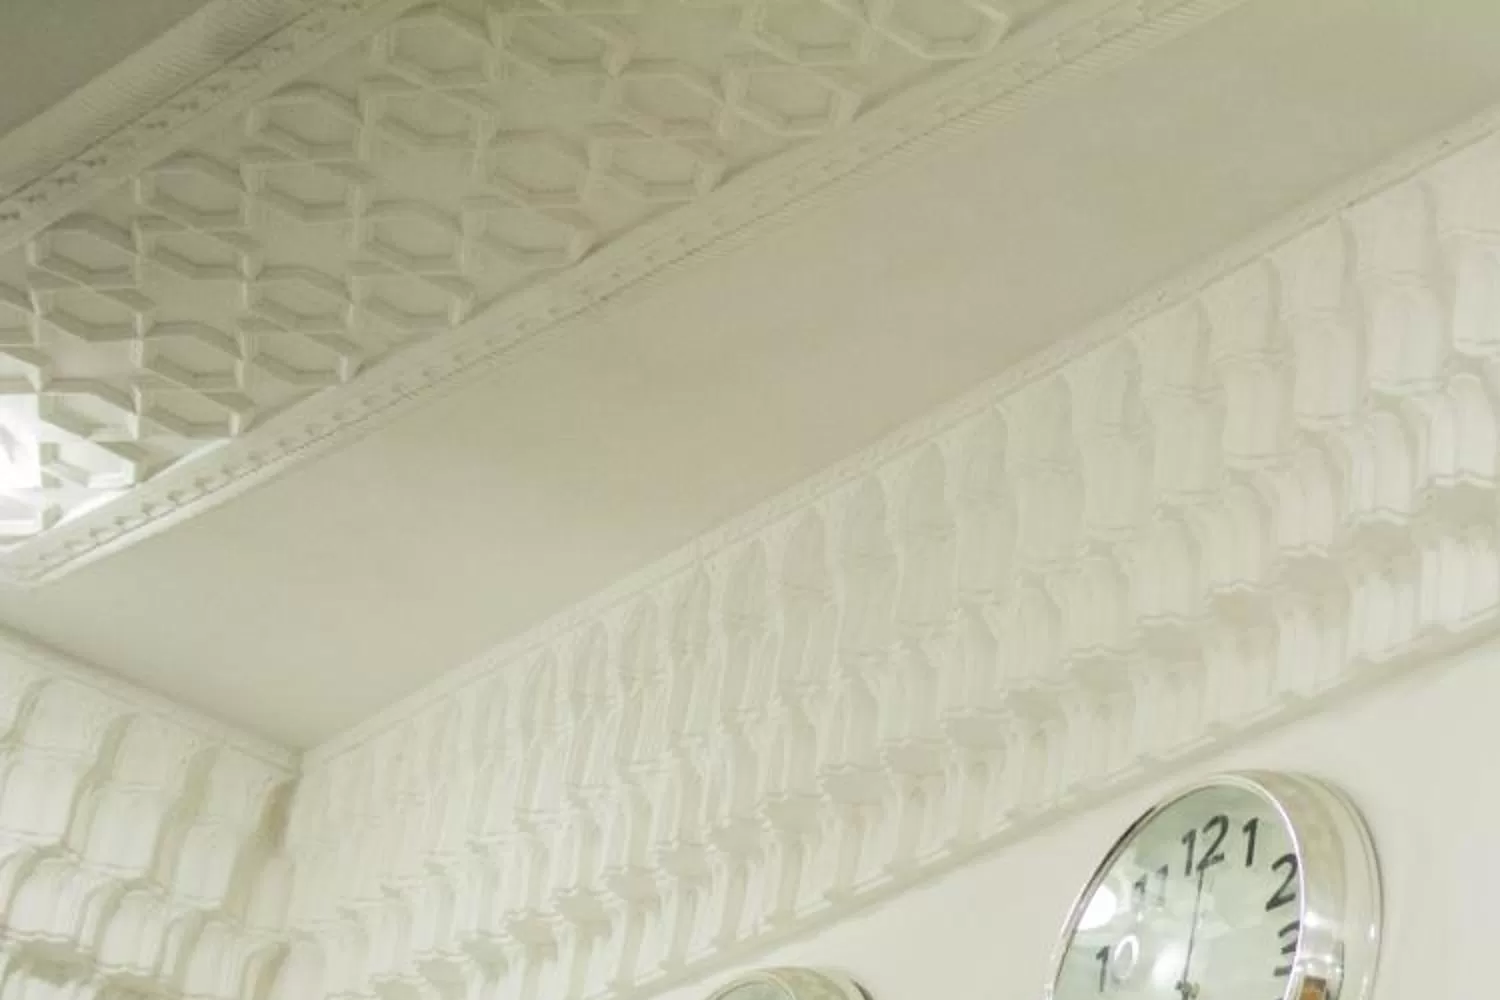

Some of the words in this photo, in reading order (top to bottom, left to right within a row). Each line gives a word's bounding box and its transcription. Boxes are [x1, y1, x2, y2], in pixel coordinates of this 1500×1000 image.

[1182, 814, 1229, 876] 12
[1242, 817, 1259, 867] 1
[1266, 853, 1298, 911] 2
